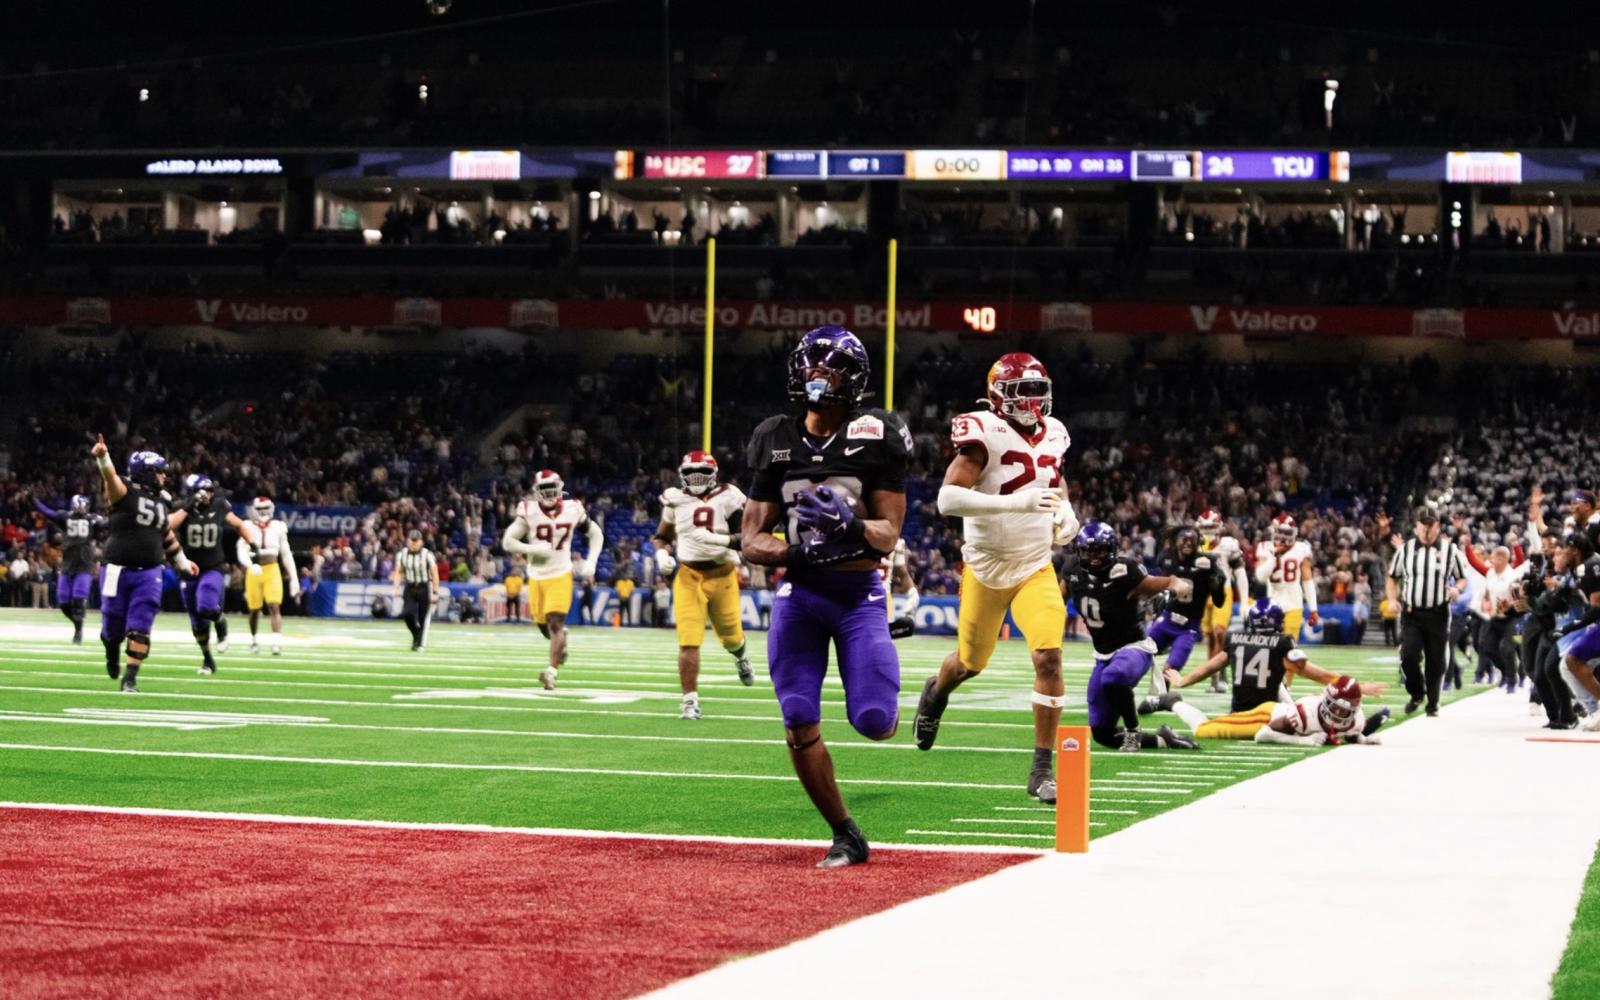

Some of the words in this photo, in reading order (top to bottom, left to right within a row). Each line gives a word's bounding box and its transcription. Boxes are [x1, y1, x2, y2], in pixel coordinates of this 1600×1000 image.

[664, 156, 705, 176] USC
[726, 155, 753, 175] 27
[934, 158, 980, 173] 0:00
[1207, 156, 1234, 176] 24
[1272, 156, 1314, 177] TCU
[231, 303, 309, 322] Valero
[645, 302, 740, 327] Valeo
[748, 303, 844, 326] Alamo
[963, 307, 996, 332] 40
[1230, 309, 1317, 331] Valero
[136, 496, 166, 528] 51
[280, 511, 357, 530] Valero
[692, 506, 714, 532] 9
[66, 518, 90, 537] 56
[187, 523, 218, 548] 60
[535, 523, 572, 550] 97
[1080, 595, 1105, 629] 0
[1234, 646, 1271, 689] 14
